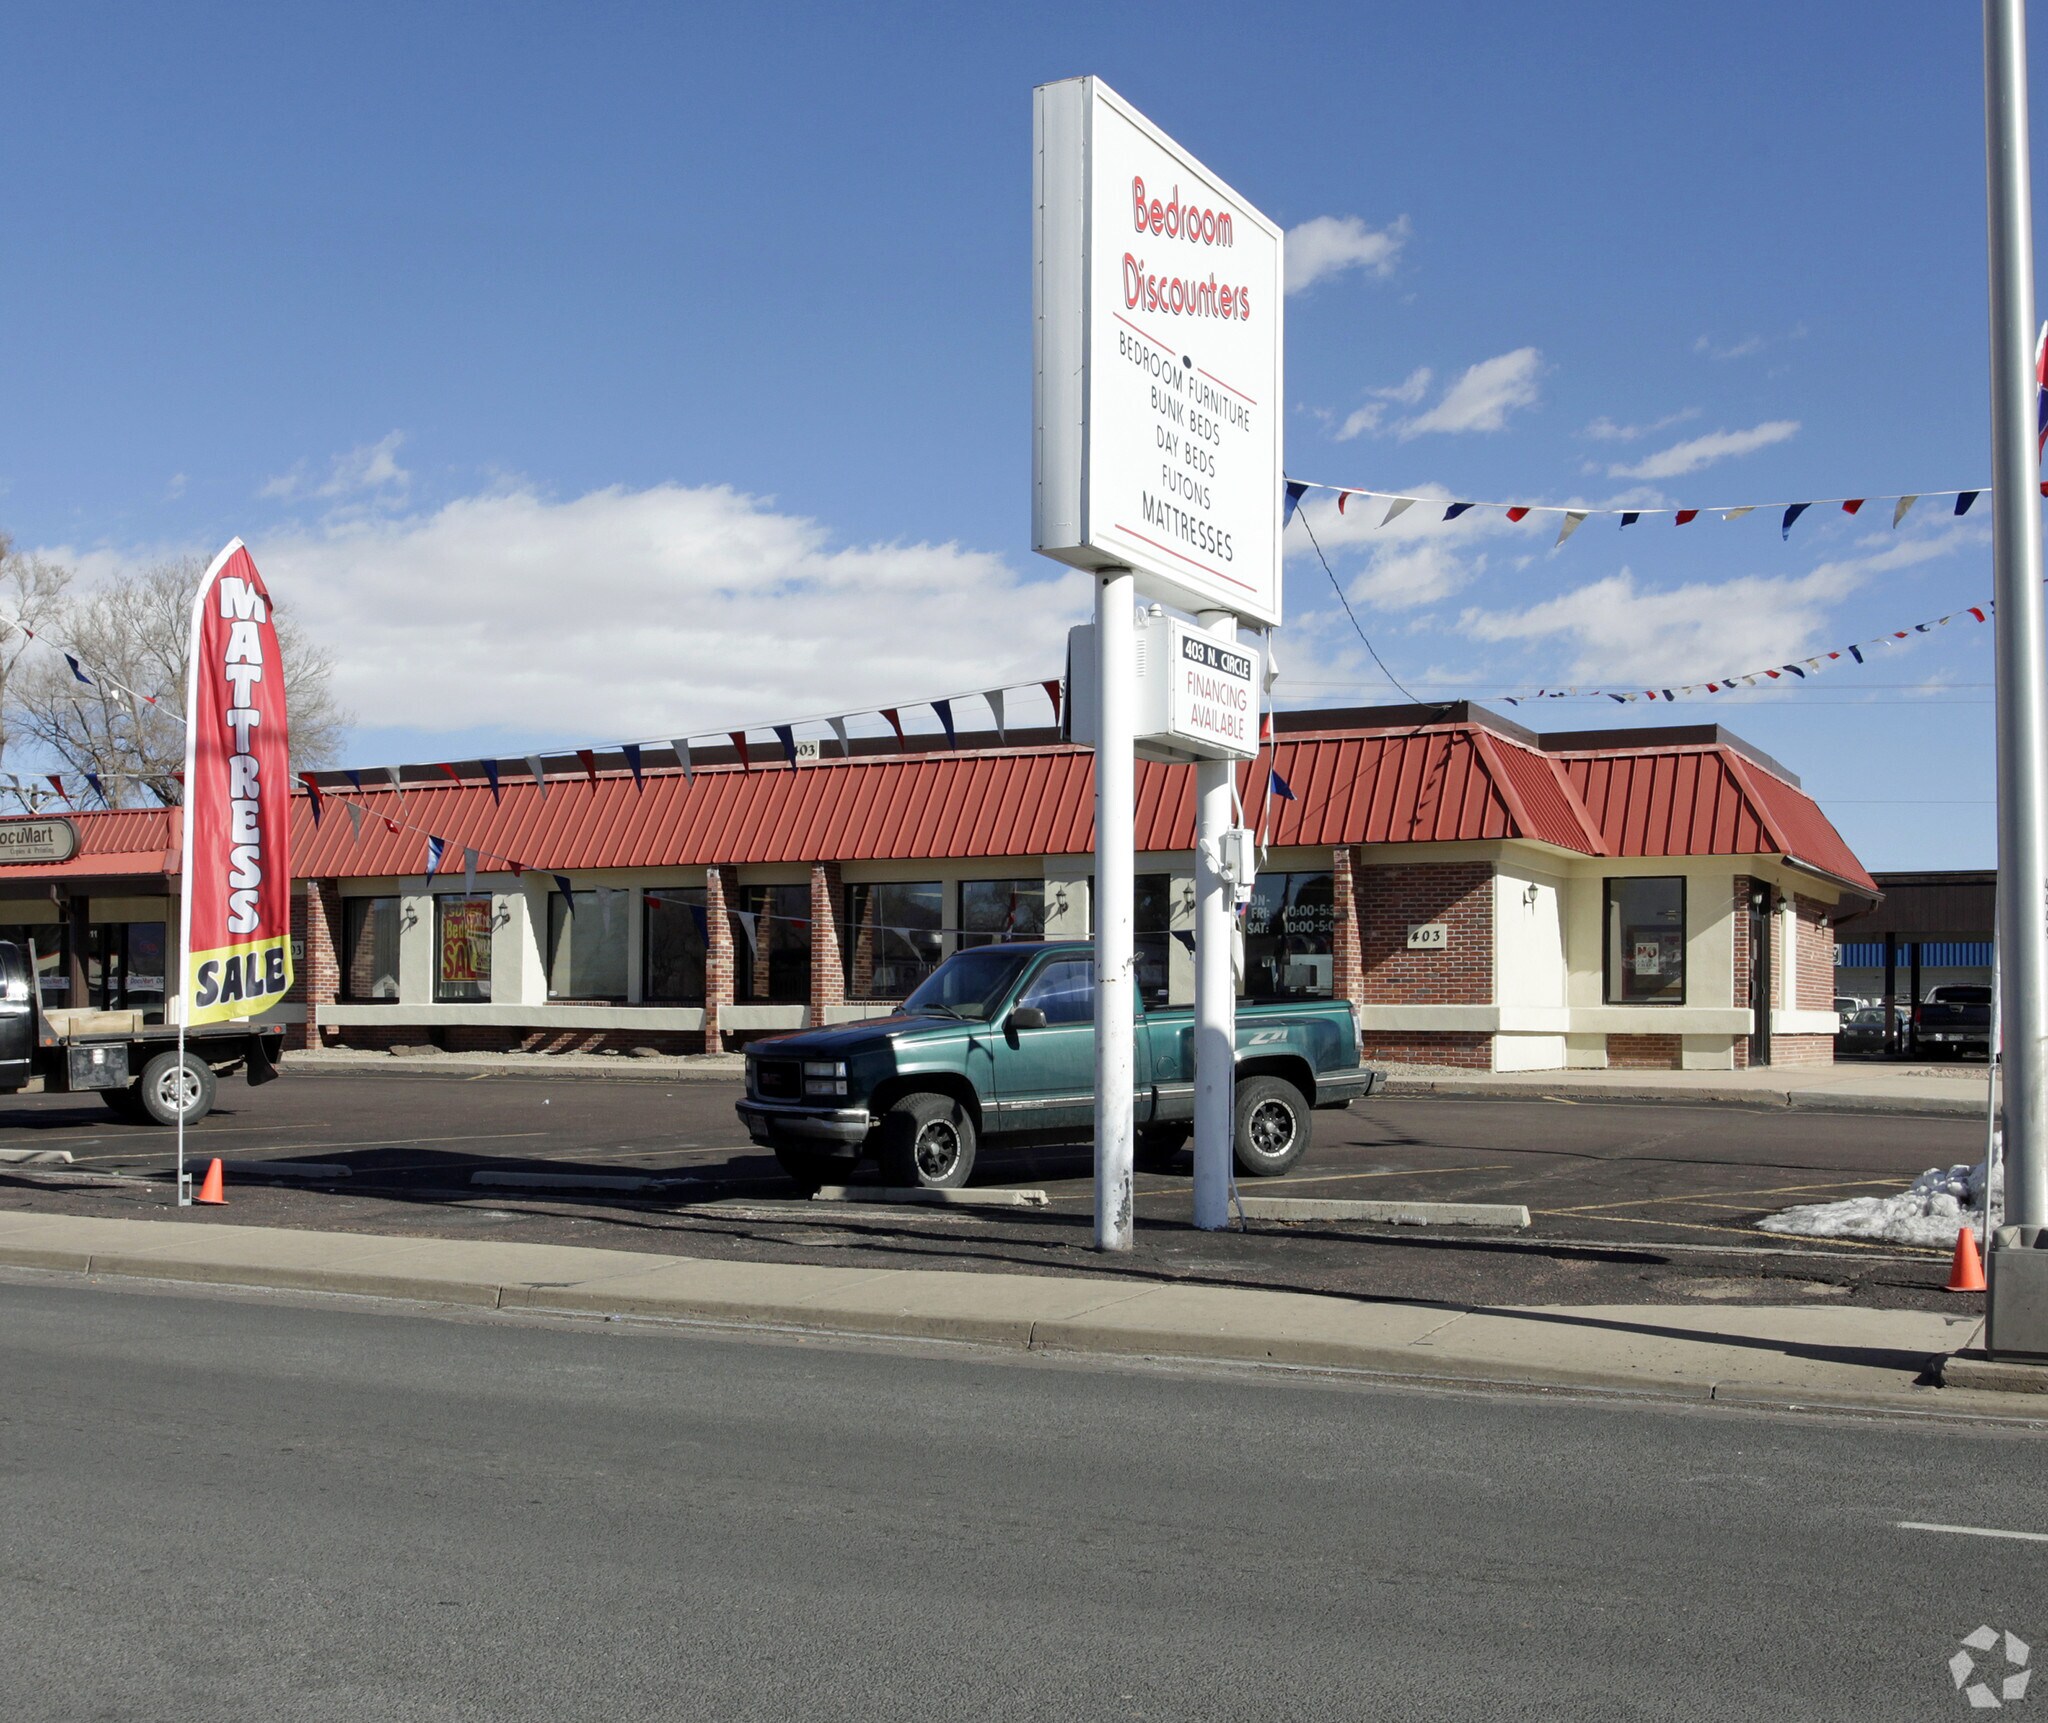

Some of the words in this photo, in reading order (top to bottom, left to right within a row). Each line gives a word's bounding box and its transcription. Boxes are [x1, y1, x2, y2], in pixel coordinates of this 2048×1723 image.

[1131, 175, 1233, 247] Bedroom
[1122, 252, 1250, 321] Discounters
[1119, 330, 1183, 393] BEDROOM
[1189, 376, 1250, 432] FURNITURE
[1151, 385, 1184, 427] BUNK
[1190, 409, 1220, 446] BEDS
[1156, 424, 1179, 458] DAY
[1185, 441, 1215, 478] BEDS
[1162, 464, 1211, 511] FUTONS
[1142, 490, 1234, 562] MATTRESSES
[1185, 639, 1204, 662] 403
[1207, 647, 1218, 667] N.
[1221, 653, 1249, 679] CIRCLE
[1187, 671, 1247, 711] FINANCING
[1191, 703, 1244, 740] AVAILABLE
[220, 576, 266, 934] MATTRESS
[0, 826, 53, 845] ocuMart
[1250, 894, 1270, 906] ON-
[1251, 907, 1270, 919] FRI:
[1284, 904, 1334, 918] 10:00-5:3
[1247, 922, 1270, 934] SAT:
[1284, 920, 1334, 934] 10:00-5:0
[1411, 930, 1440, 942] 403
[195, 944, 288, 1008] SALE
[443, 943, 477, 979] SAL
